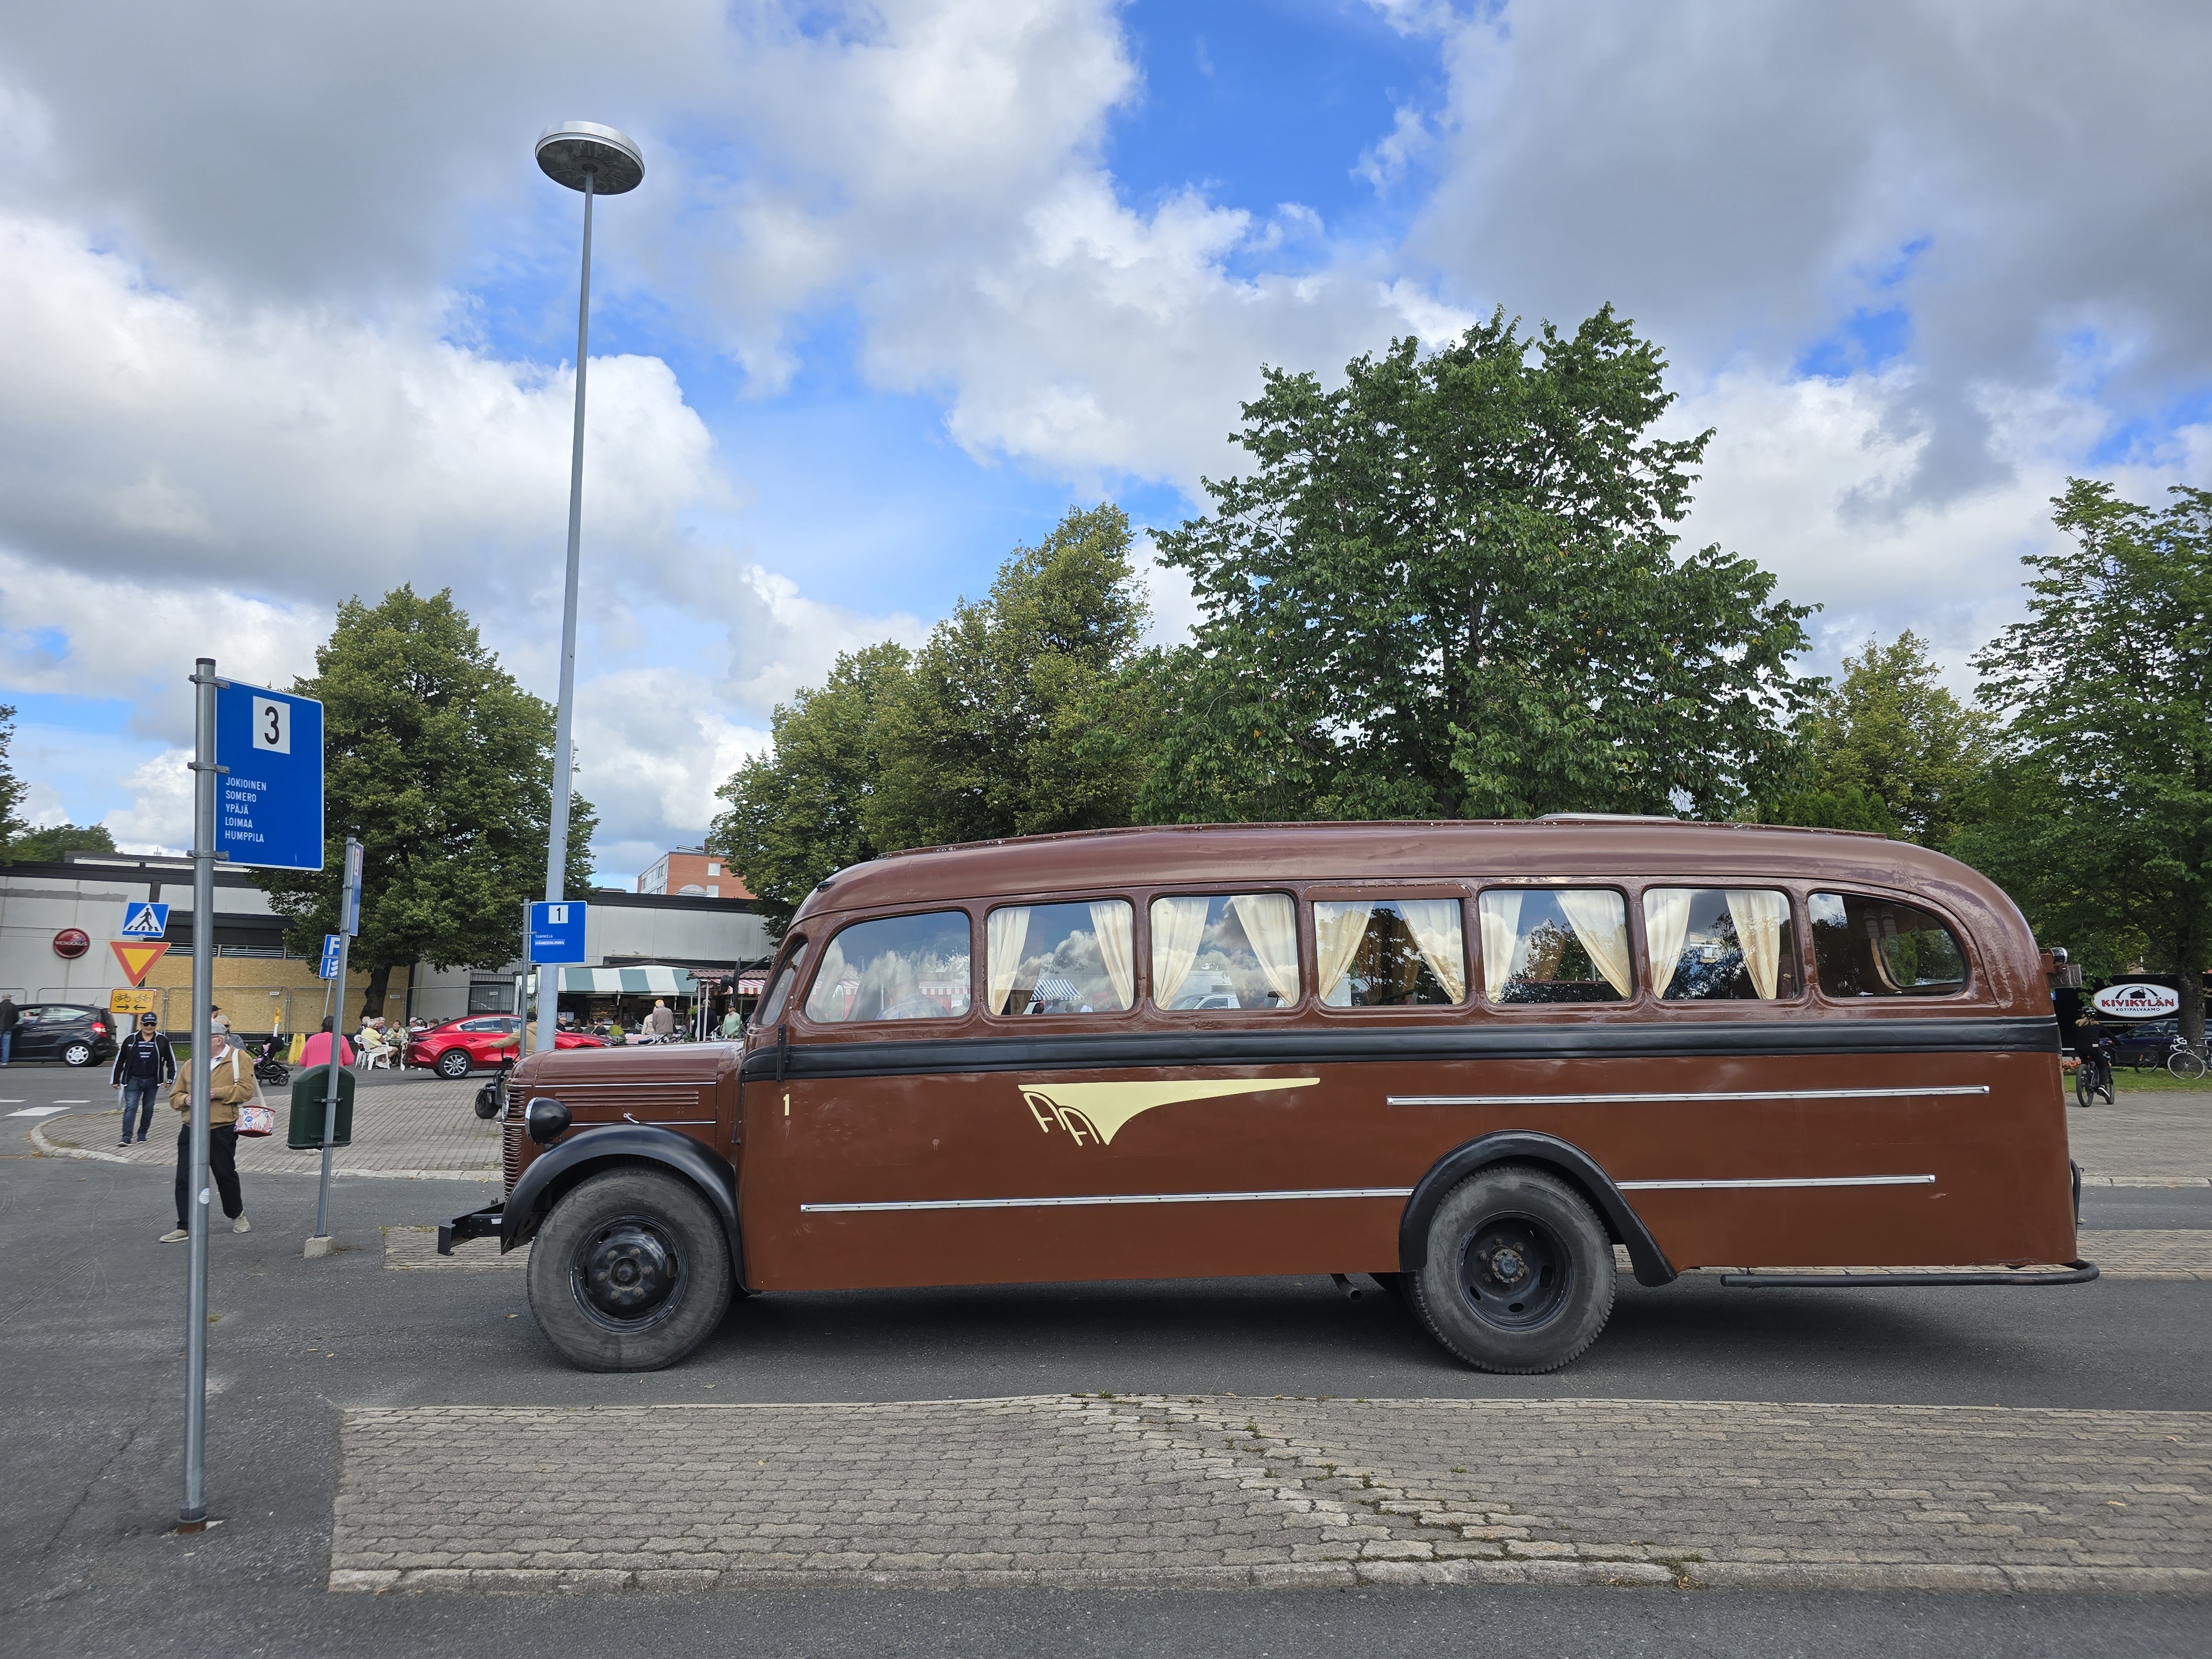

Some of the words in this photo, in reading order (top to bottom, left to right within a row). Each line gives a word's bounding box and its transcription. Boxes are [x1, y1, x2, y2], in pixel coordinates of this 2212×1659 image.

[264, 706, 279, 745] 3
[226, 777, 267, 791] JOKIOINEN
[226, 790, 257, 802] SOMERO
[226, 803, 248, 815] YPÄJÄ
[225, 817, 253, 828] LOIMAA
[225, 830, 264, 842] HUMPPILA
[556, 907, 561, 921] 1
[2101, 997, 2174, 1007] KIVIKYLÄN
[783, 1093, 790, 1116] 1
